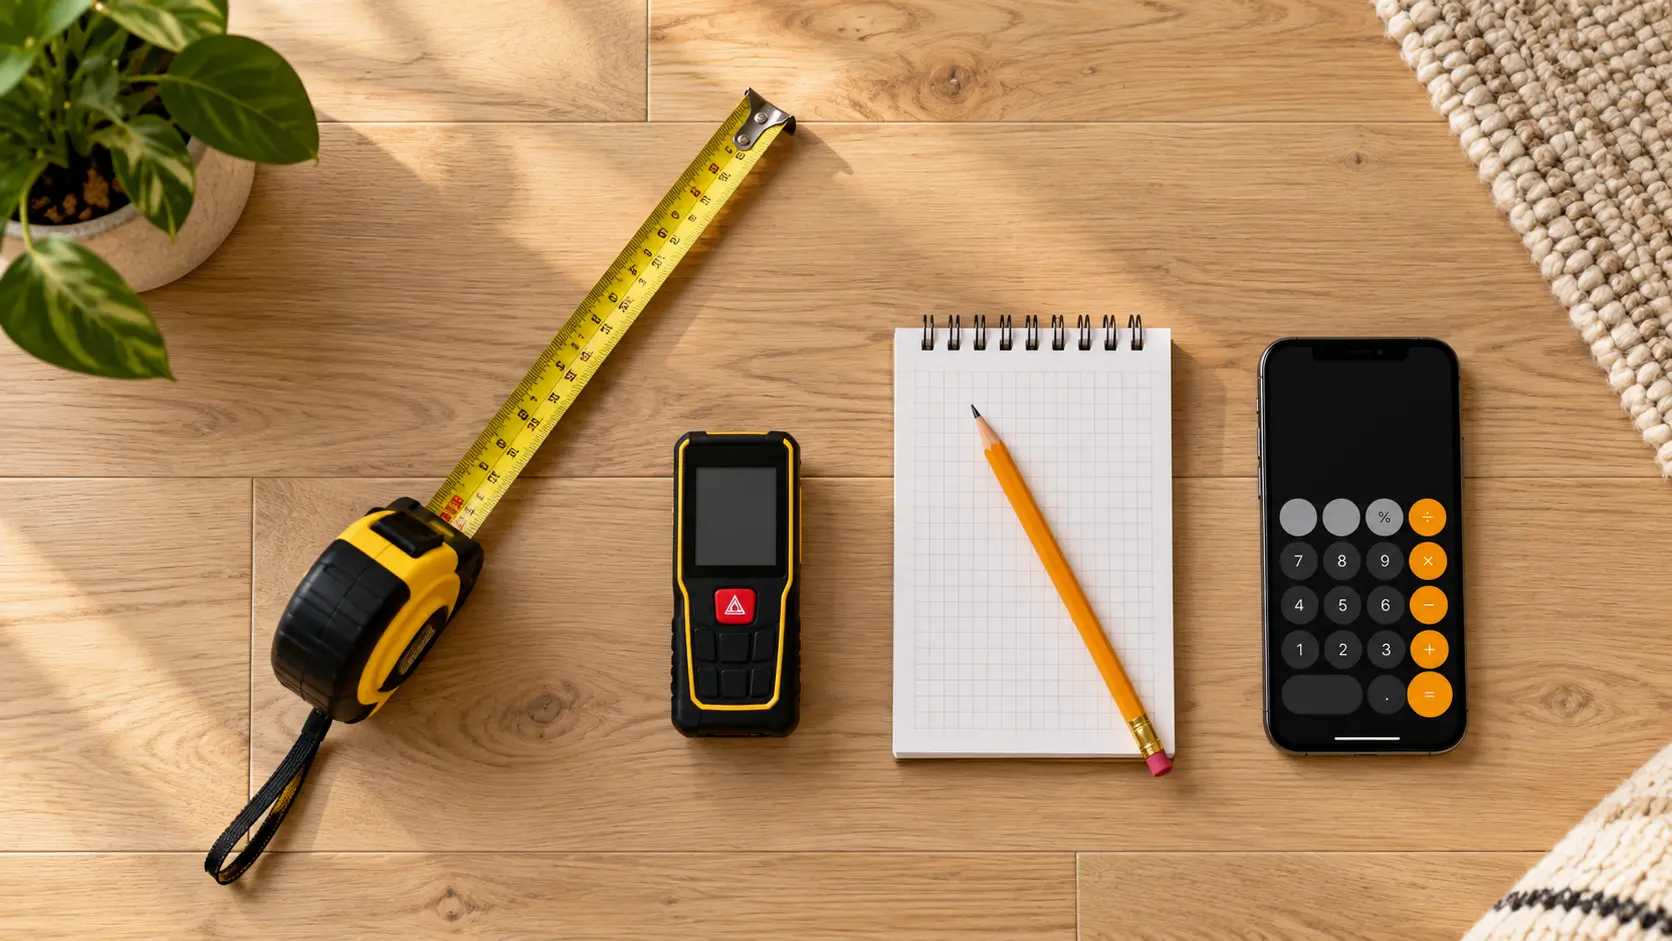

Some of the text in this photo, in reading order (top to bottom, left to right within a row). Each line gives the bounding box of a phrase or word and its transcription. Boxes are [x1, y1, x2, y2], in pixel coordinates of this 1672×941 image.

[1378, 511, 1391, 523] %
[1294, 554, 1303, 567] 7
[1337, 554, 1347, 567] 8
[1380, 554, 1390, 567] 9
[1294, 598, 1304, 611] 4
[1338, 598, 1348, 611] 5
[1381, 598, 1391, 611] 6
[1296, 643, 1435, 656] 1 2 3 +
